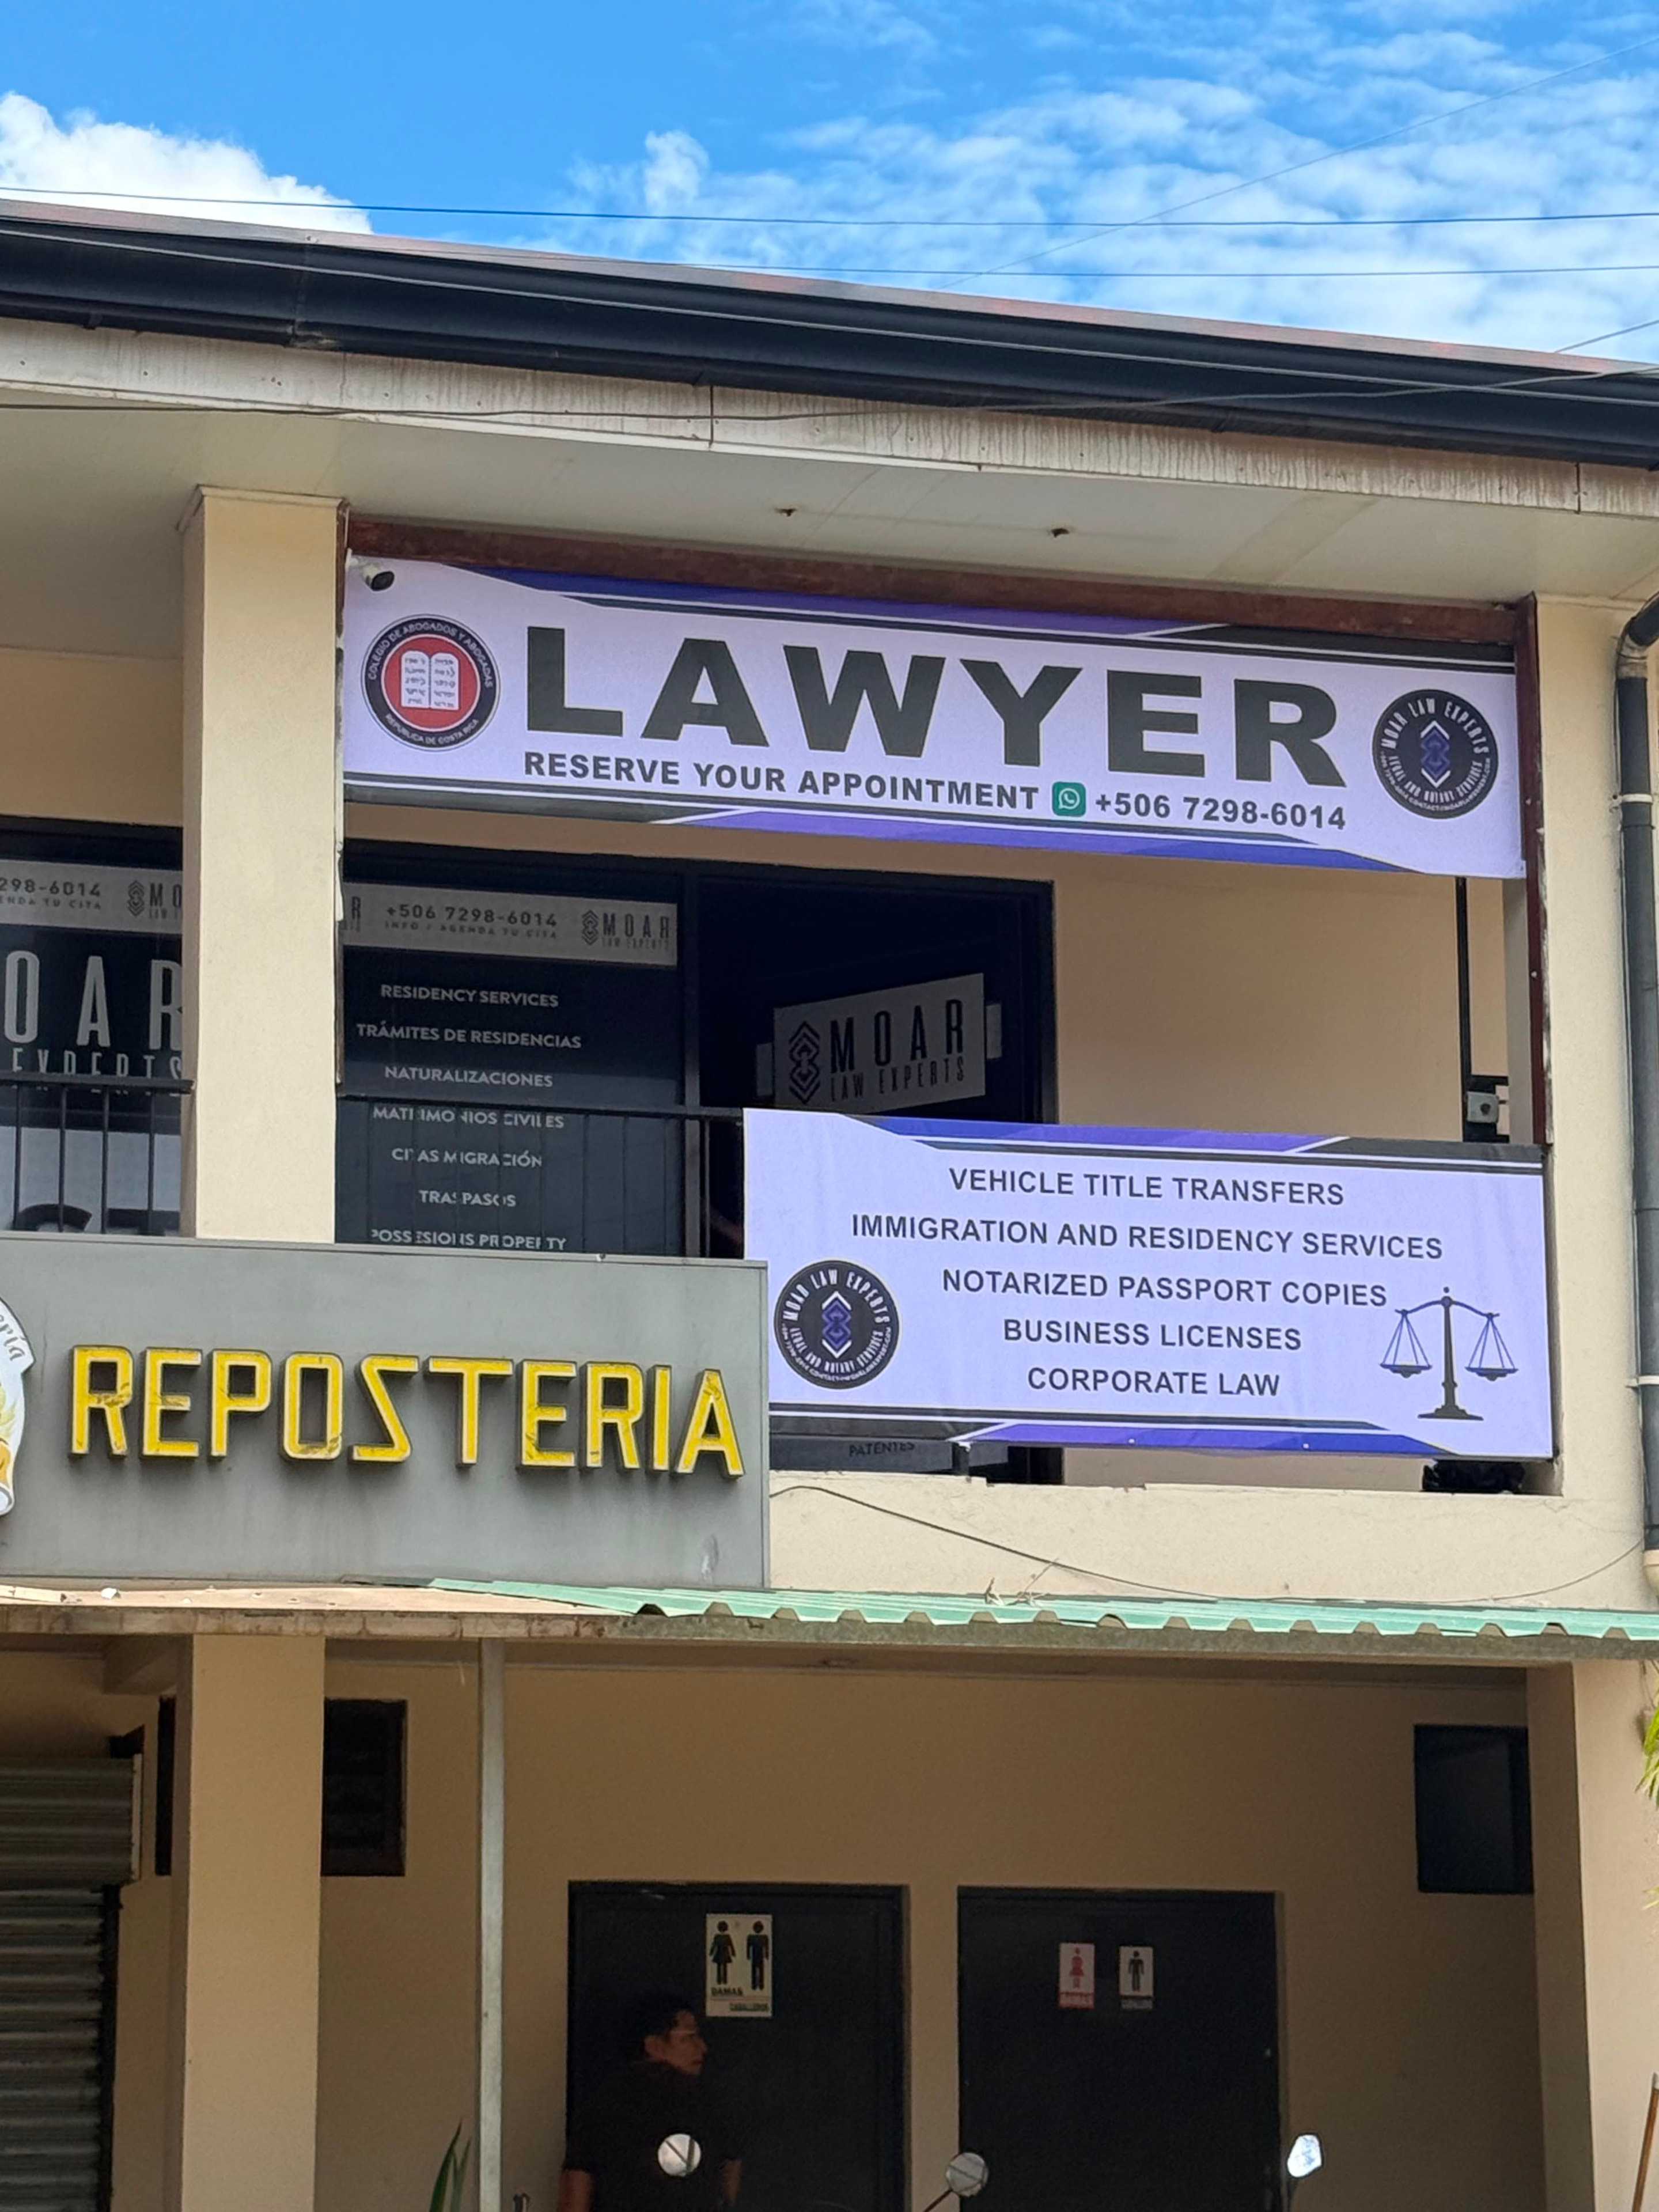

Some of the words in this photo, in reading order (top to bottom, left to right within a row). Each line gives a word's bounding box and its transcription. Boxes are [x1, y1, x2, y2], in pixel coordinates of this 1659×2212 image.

[388, 630, 403, 642] DE
[403, 622, 458, 637] ABOGADOS
[458, 632, 465, 641] Y
[464, 638, 494, 688] ABOGADAS
[528, 626, 1346, 787] LAWYER
[1408, 698, 1435, 718] LAW
[1444, 700, 1490, 755] EXPERTS
[524, 751, 680, 785] RESERVE
[693, 763, 785, 792] YOUR
[798, 770, 1039, 809] APPOINTMENT
[1096, 792, 1171, 821] +506
[1184, 797, 1346, 831] 7298-6014
[387, 903, 436, 919] +506
[445, 906, 558, 927] 7298-6014
[603, 912, 669, 939] MOAR
[381, 983, 476, 1003] RESIDENCY
[479, 990, 559, 1008] SERVICES
[356, 1020, 440, 1041] TRÁMITES
[443, 1028, 467, 1043] DE
[470, 1029, 582, 1050] RESIDENCIAS
[830, 999, 964, 1074] MOAR
[385, 1066, 554, 1088] NATURALIZACIONES
[830, 1074, 864, 1102] LAW
[879, 1056, 964, 1094] EXPERTS
[391, 1147, 440, 1164] CIAS
[949, 1168, 1074, 1195] VEHICLE
[1084, 1173, 1162, 1198] TITLE
[1173, 1177, 1344, 1206] TRANSFERS
[852, 1214, 1048, 1244] IMMIGRATION
[1057, 1224, 1118, 1247] AND
[1128, 1226, 1294, 1253] RESIDENCY
[1302, 1233, 1442, 1259] SERVICES
[810, 1269, 838, 1289] LAW
[846, 1271, 891, 1324] EXPERTS
[942, 1268, 1108, 1298] NOTARIZED
[1119, 1275, 1272, 1303] PASSPORT
[1281, 1282, 1387, 1306] COPIES
[1003, 1319, 1150, 1346] BUSINESS
[1160, 1324, 1301, 1351] LICENSES
[1027, 1368, 1207, 1394] CORPORATE
[1218, 1372, 1280, 1396] LAW
[69, 1344, 747, 1479] REPOSTERIA
